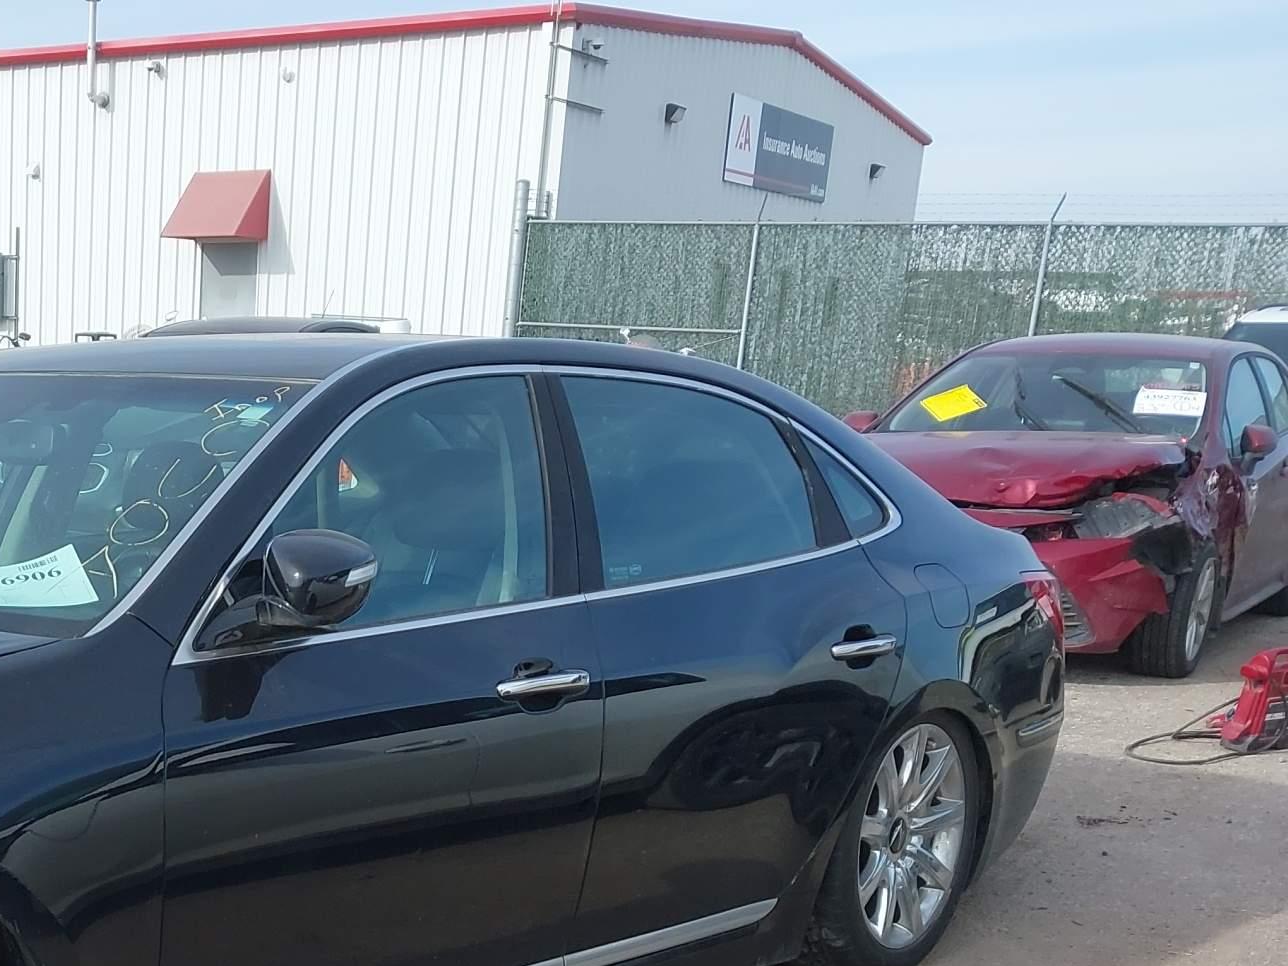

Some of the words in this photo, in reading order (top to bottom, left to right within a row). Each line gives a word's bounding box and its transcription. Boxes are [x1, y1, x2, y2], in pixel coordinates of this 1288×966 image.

[762, 131, 790, 156] Insurance
[790, 140, 804, 160] Auto
[802, 144, 826, 166] Auctions
